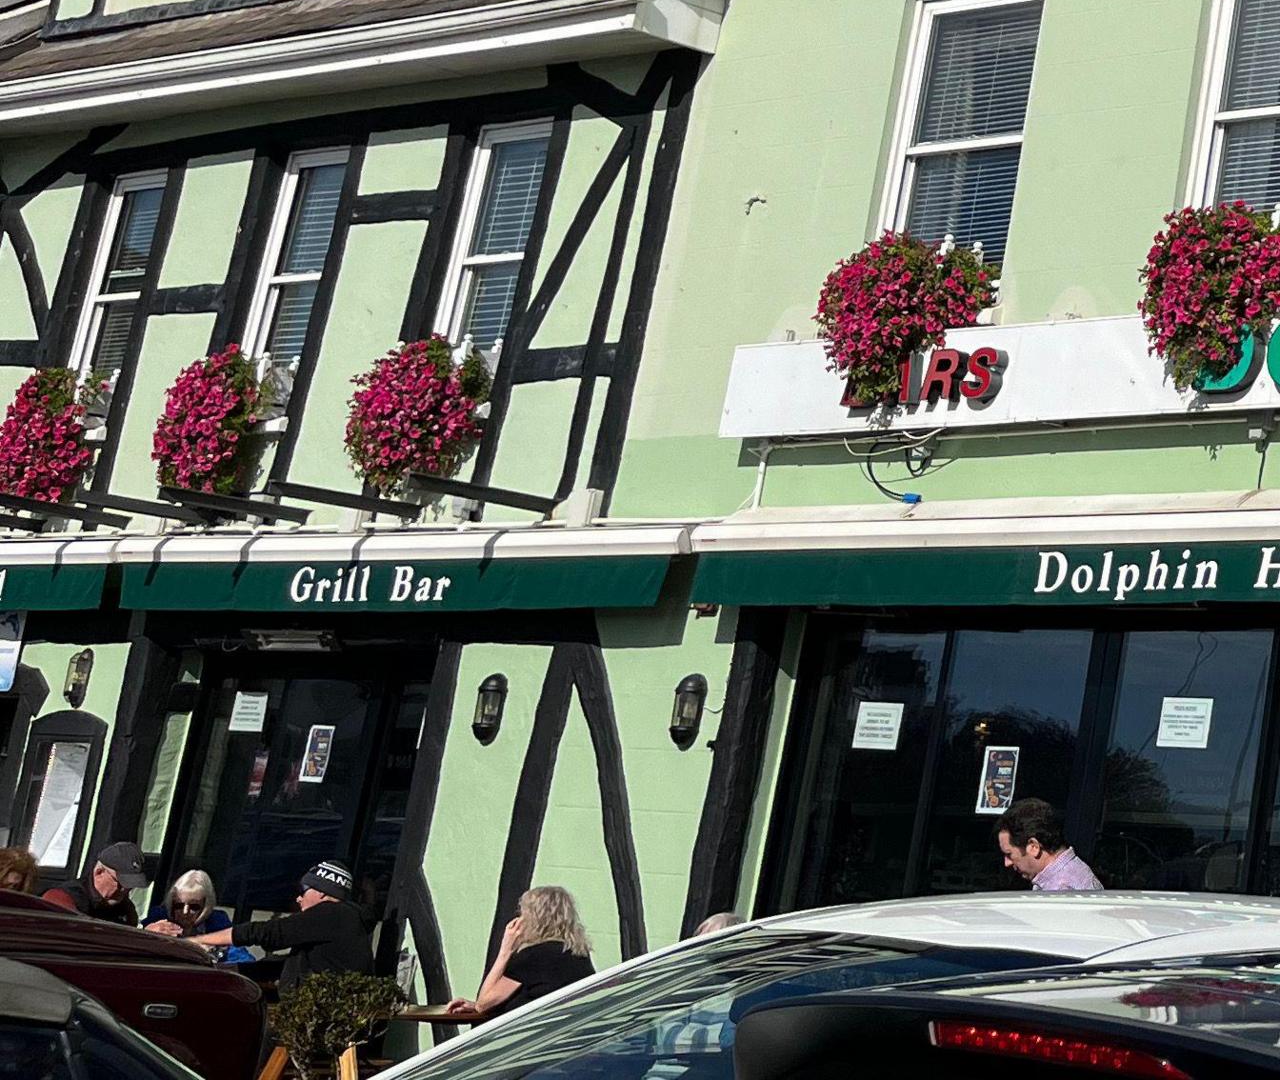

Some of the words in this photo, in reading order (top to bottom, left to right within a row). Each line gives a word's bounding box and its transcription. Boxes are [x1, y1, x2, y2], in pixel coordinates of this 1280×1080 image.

[289, 565, 371, 603] Grill
[388, 565, 452, 603] Bar
[1033, 549, 1219, 600] Dolphin
